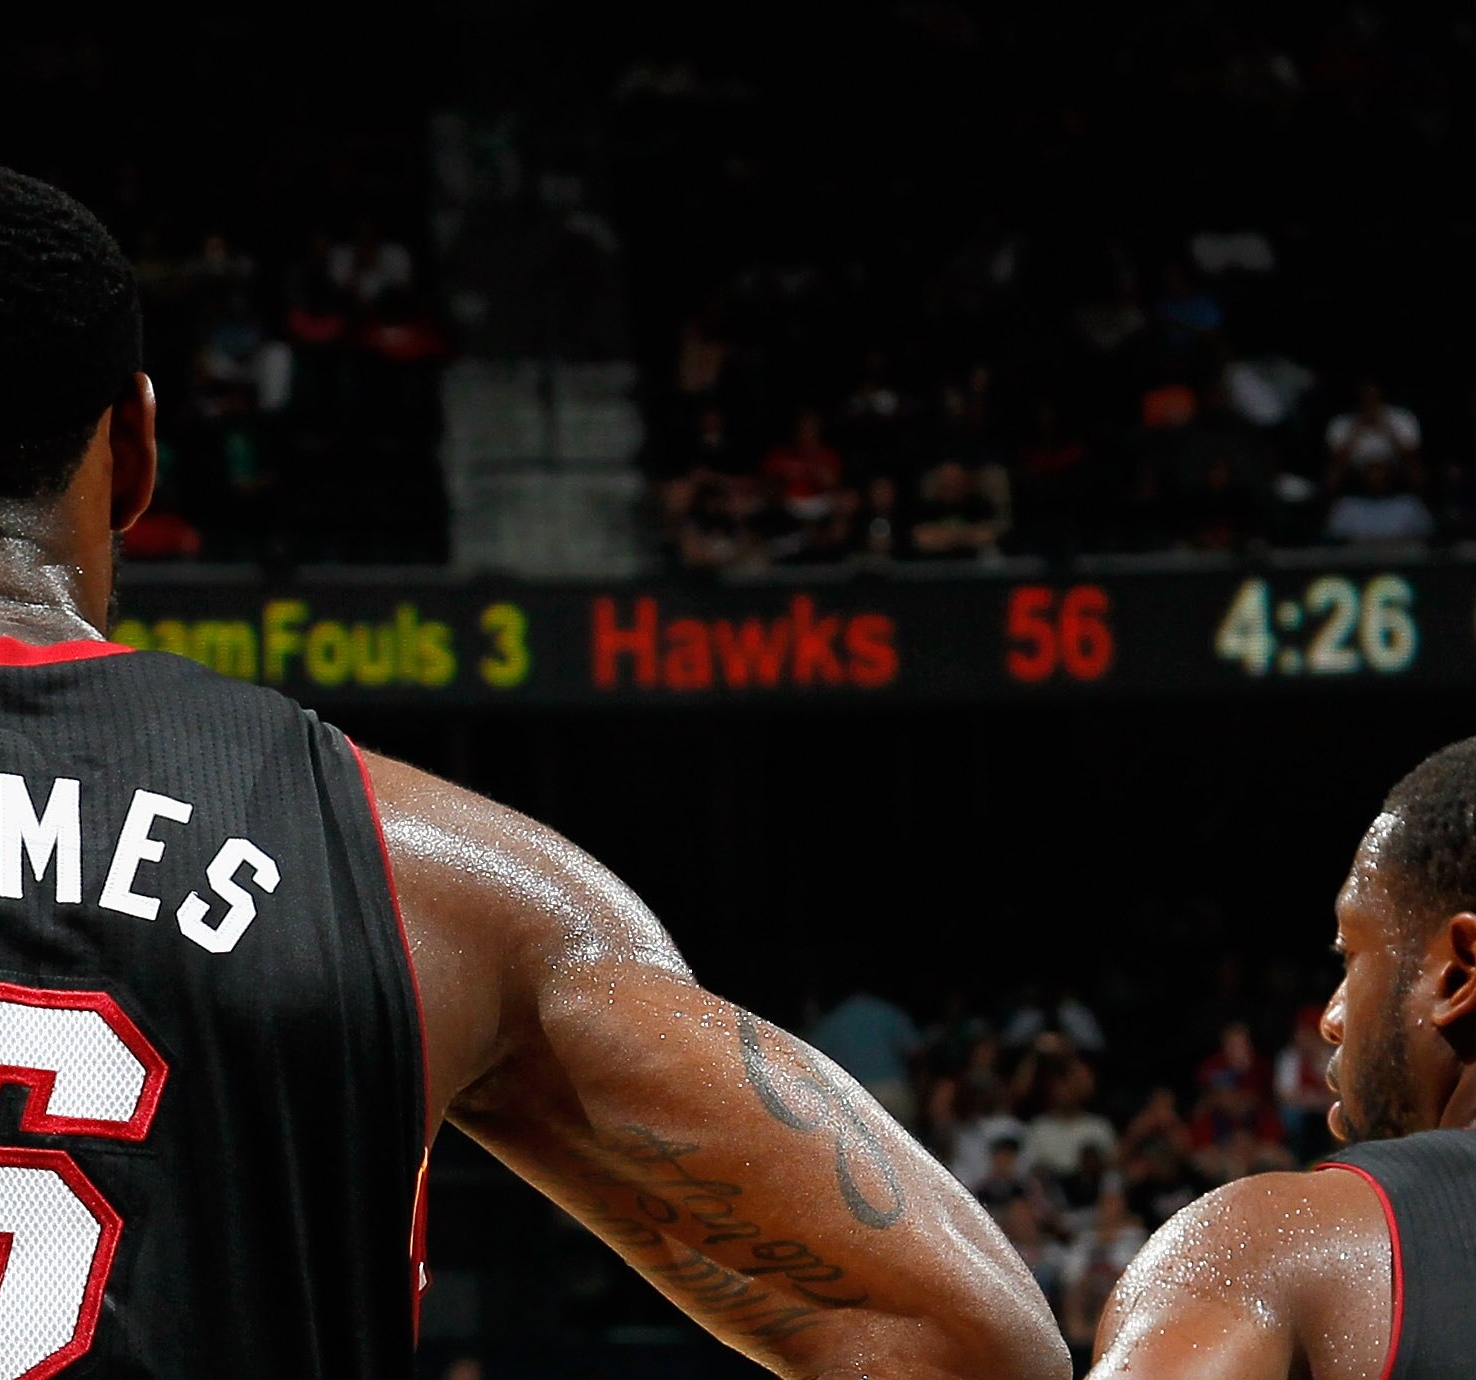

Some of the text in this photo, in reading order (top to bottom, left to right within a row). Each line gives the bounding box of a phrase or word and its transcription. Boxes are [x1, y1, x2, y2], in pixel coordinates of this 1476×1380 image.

[482, 604, 528, 686] 3
[593, 586, 1113, 690] Hawks 56
[1217, 575, 1418, 675] 4:26
